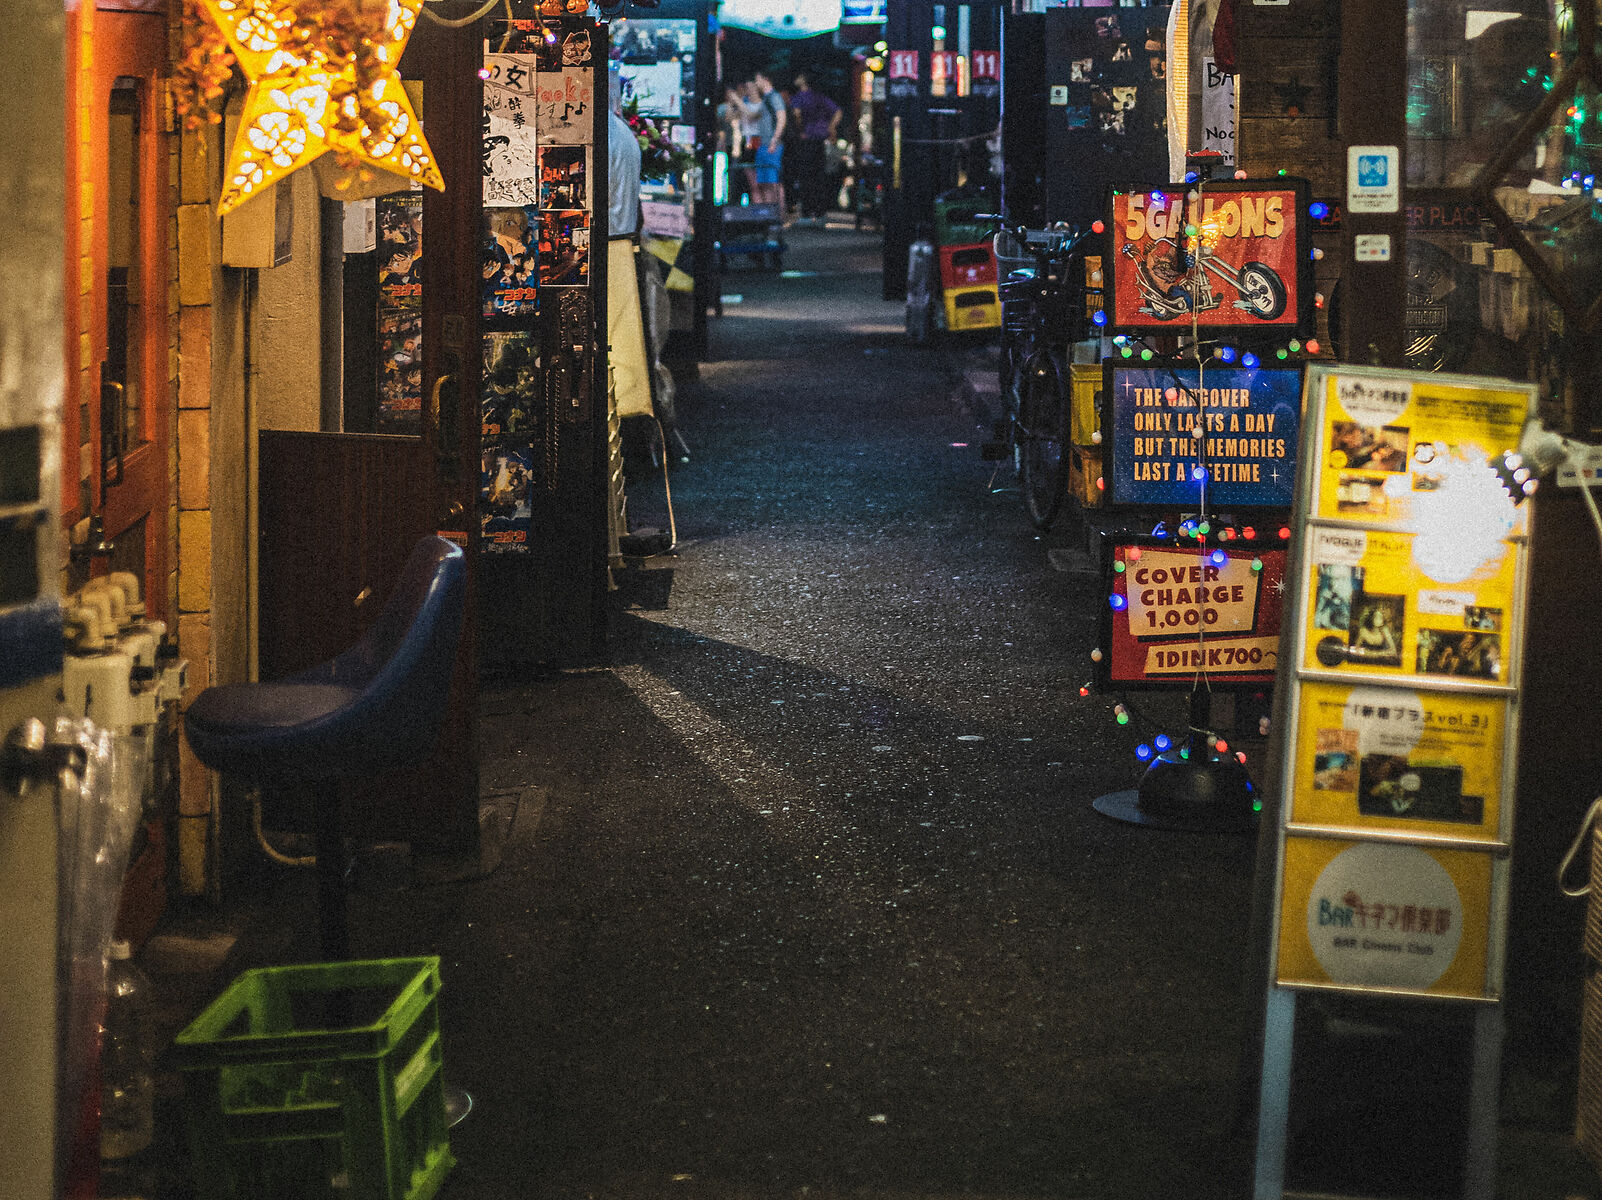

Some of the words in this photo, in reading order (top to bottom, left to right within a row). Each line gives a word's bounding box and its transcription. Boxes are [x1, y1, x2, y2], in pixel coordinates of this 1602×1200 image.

[1134, 388, 1162, 407] THE
[1134, 413, 1172, 432] ONLY
[1177, 413, 1225, 432] LASTS
[1230, 414, 1240, 432] A
[1245, 414, 1276, 433] DAY
[1134, 438, 1165, 456] BUT
[1169, 438, 1198, 457] THE
[1204, 438, 1285, 458] MEMORIES
[1134, 462, 1171, 481] LAST
[1176, 463, 1187, 481] A
[1191, 463, 1261, 483] LETIME
[1135, 565, 1220, 585] COVER
[1140, 585, 1244, 606] CHARGE
[1146, 608, 1219, 630] 1,000
